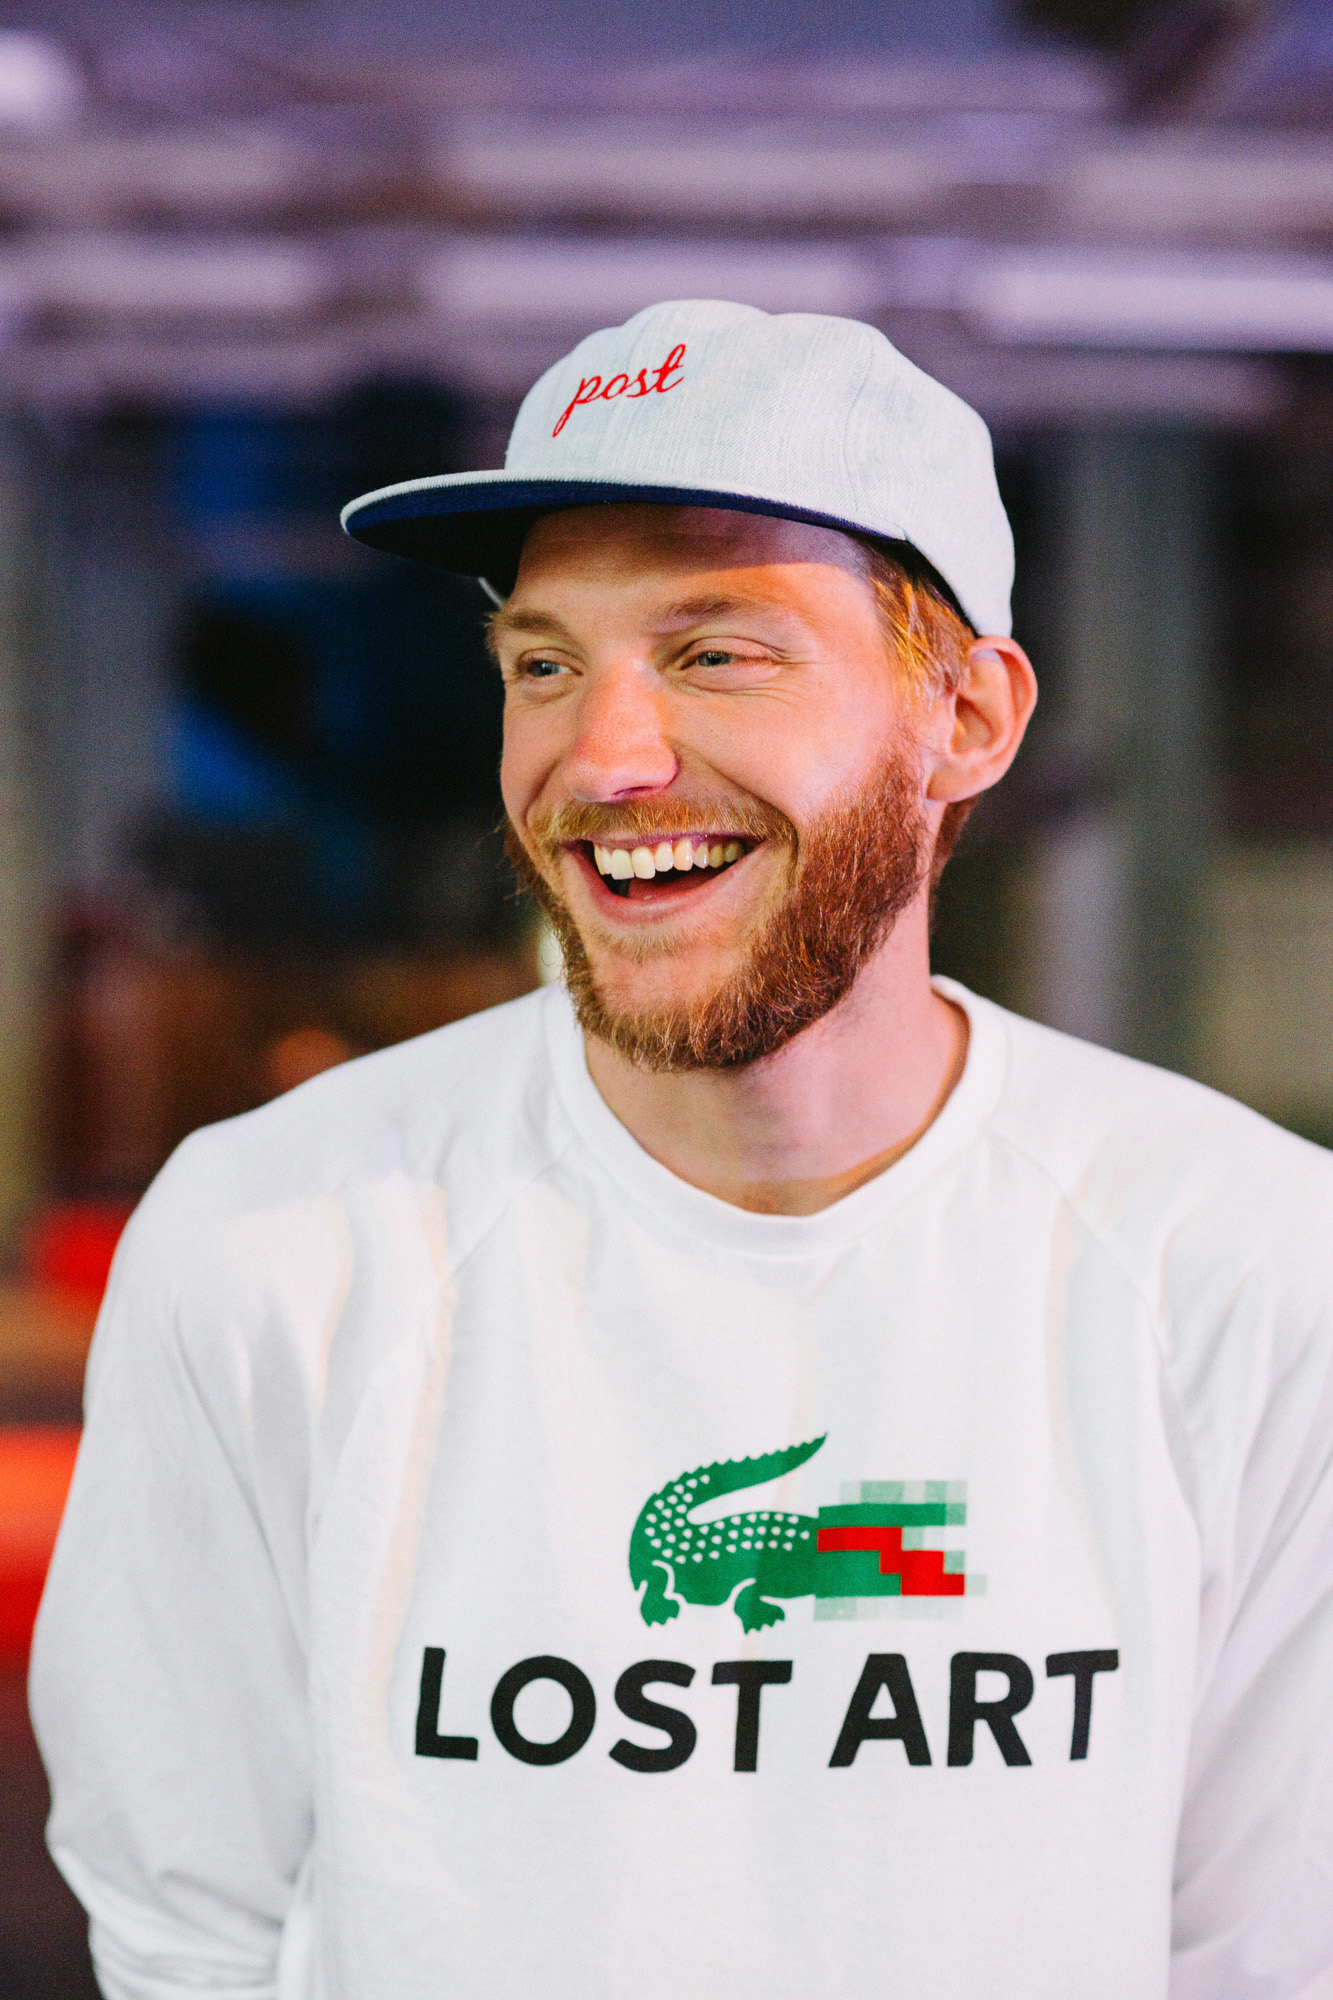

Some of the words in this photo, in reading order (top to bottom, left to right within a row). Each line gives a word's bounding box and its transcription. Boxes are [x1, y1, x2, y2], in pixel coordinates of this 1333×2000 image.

[552, 344, 686, 438] post
[414, 1646, 793, 1773] LOST
[828, 1649, 1120, 1768] ART
